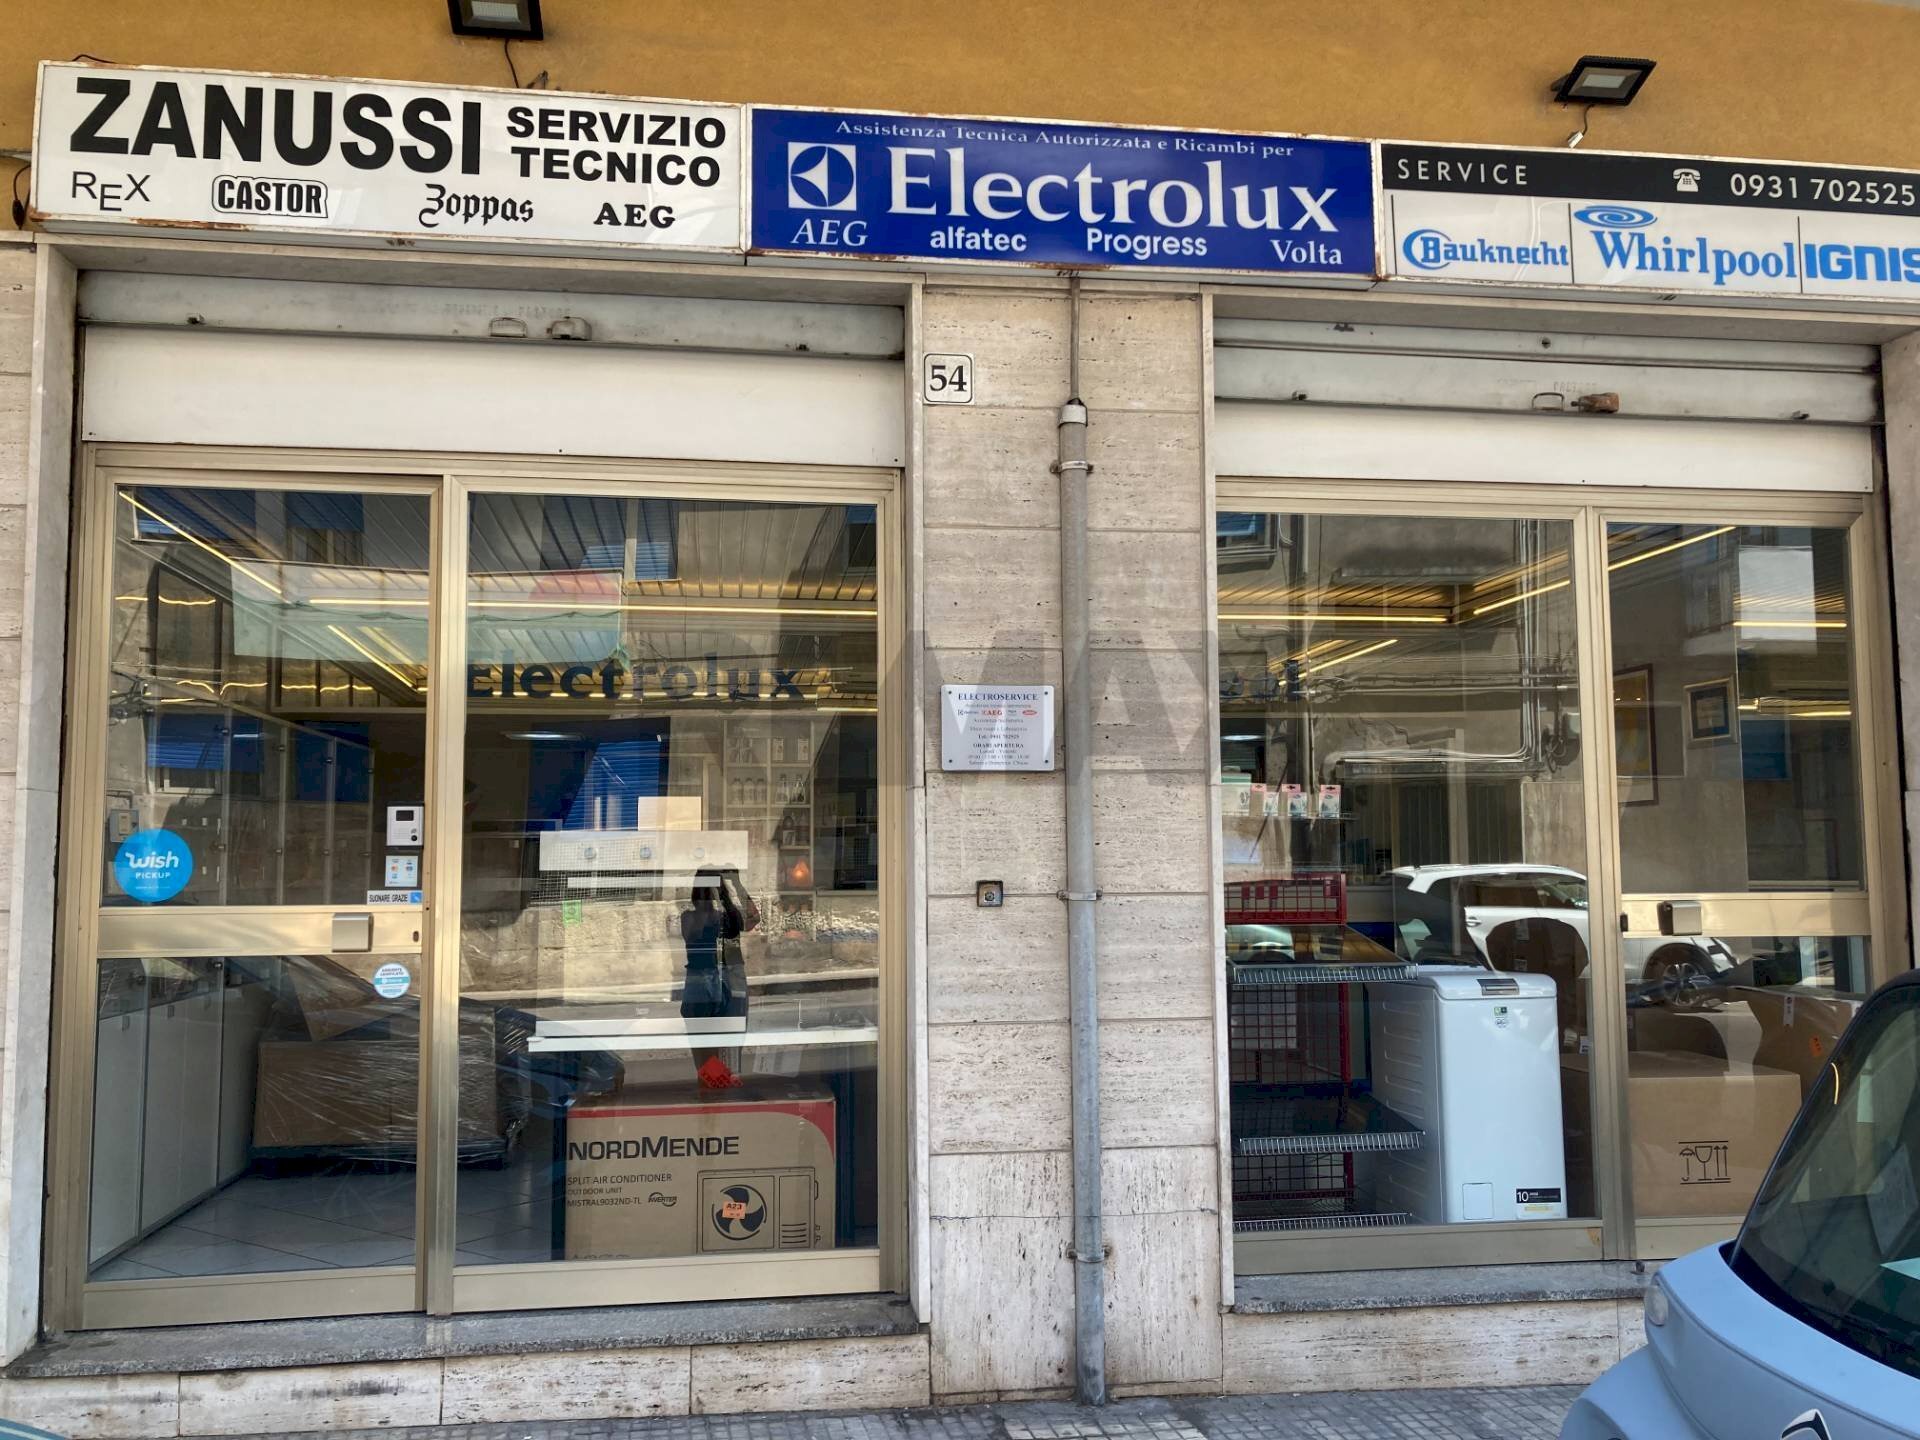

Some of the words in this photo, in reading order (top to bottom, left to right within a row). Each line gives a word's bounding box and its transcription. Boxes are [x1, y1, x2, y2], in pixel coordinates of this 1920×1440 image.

[70, 77, 482, 175] ZANUSSI
[506, 106, 726, 149] SERVIZIO
[836, 120, 946, 139] Assistenza
[951, 126, 1028, 143] Tecnica
[1035, 131, 1151, 150] Autorizzata
[1157, 140, 1168, 150] e
[1174, 137, 1255, 154] Ricambi
[1262, 144, 1294, 159] per
[510, 146, 721, 188] TECNICO
[1397, 158, 1528, 185] SERVICE
[71, 170, 150, 211] REX
[217, 179, 323, 214] CASTOR
[886, 146, 1339, 233] Electrolux
[1729, 172, 1798, 199] 0931
[1809, 178, 1915, 207] 702525
[418, 183, 534, 228] Zoppas
[593, 202, 676, 229] AEG
[790, 218, 869, 247] AEG
[930, 225, 1028, 252] alfatec
[1087, 227, 1208, 260] Progress
[1270, 239, 1343, 265] Volta
[1403, 229, 1569, 270] Bauknecht
[1590, 230, 1797, 285] Whirlpool
[929, 364, 968, 392] 54
[958, 693, 1039, 701] ELECTROSERVICE
[125, 850, 180, 869] wish
[135, 871, 171, 880] PICKUP
[568, 1136, 739, 1160] NORDMENDE
[567, 1175, 592, 1185] SPLIT
[592, 1174, 608, 1184] AIR
[609, 1173, 673, 1184] CONDITIONER
[567, 1187, 604, 1196] OUTDOOR
[605, 1186, 623, 1195] UNIT
[1516, 1191, 1529, 1202] 10
